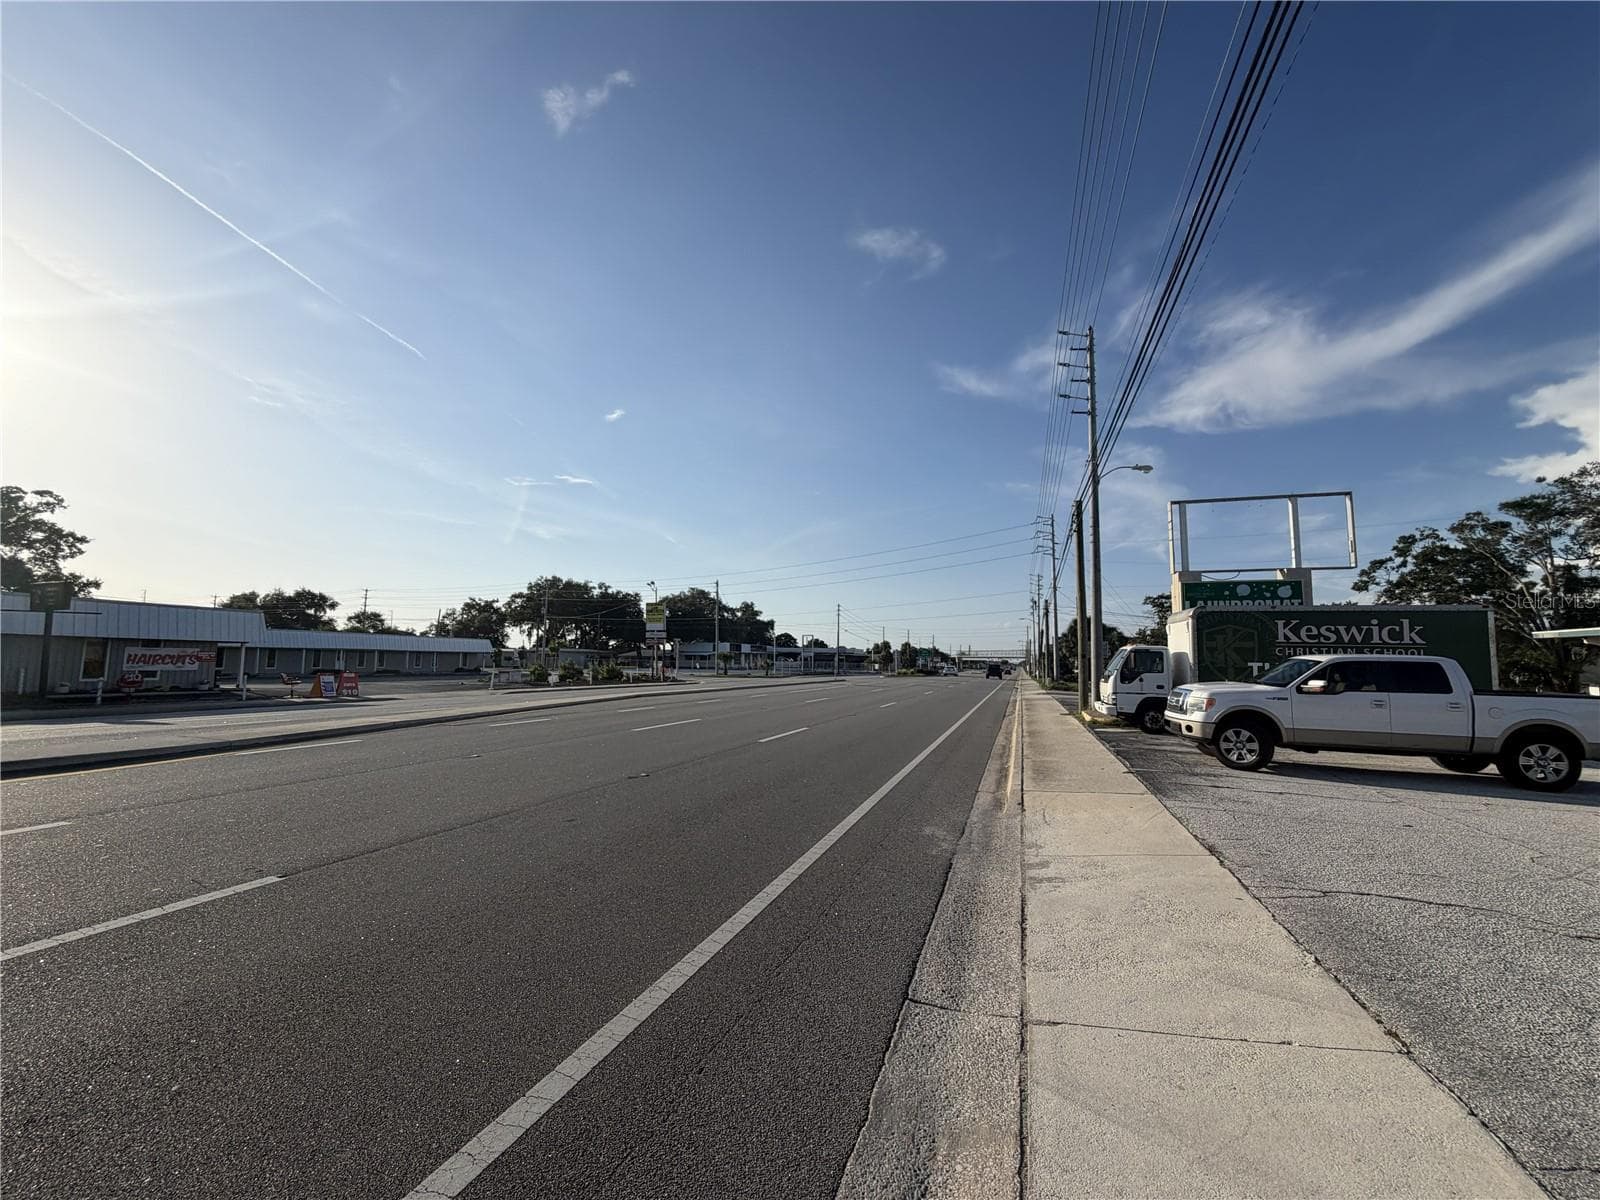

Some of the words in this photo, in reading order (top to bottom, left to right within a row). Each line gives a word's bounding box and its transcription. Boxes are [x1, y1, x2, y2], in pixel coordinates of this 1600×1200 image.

[1274, 618, 1427, 644] Keswick
[1275, 647, 1356, 656] CHRISTIAN
[126, 652, 196, 665] HAIRCUTS
